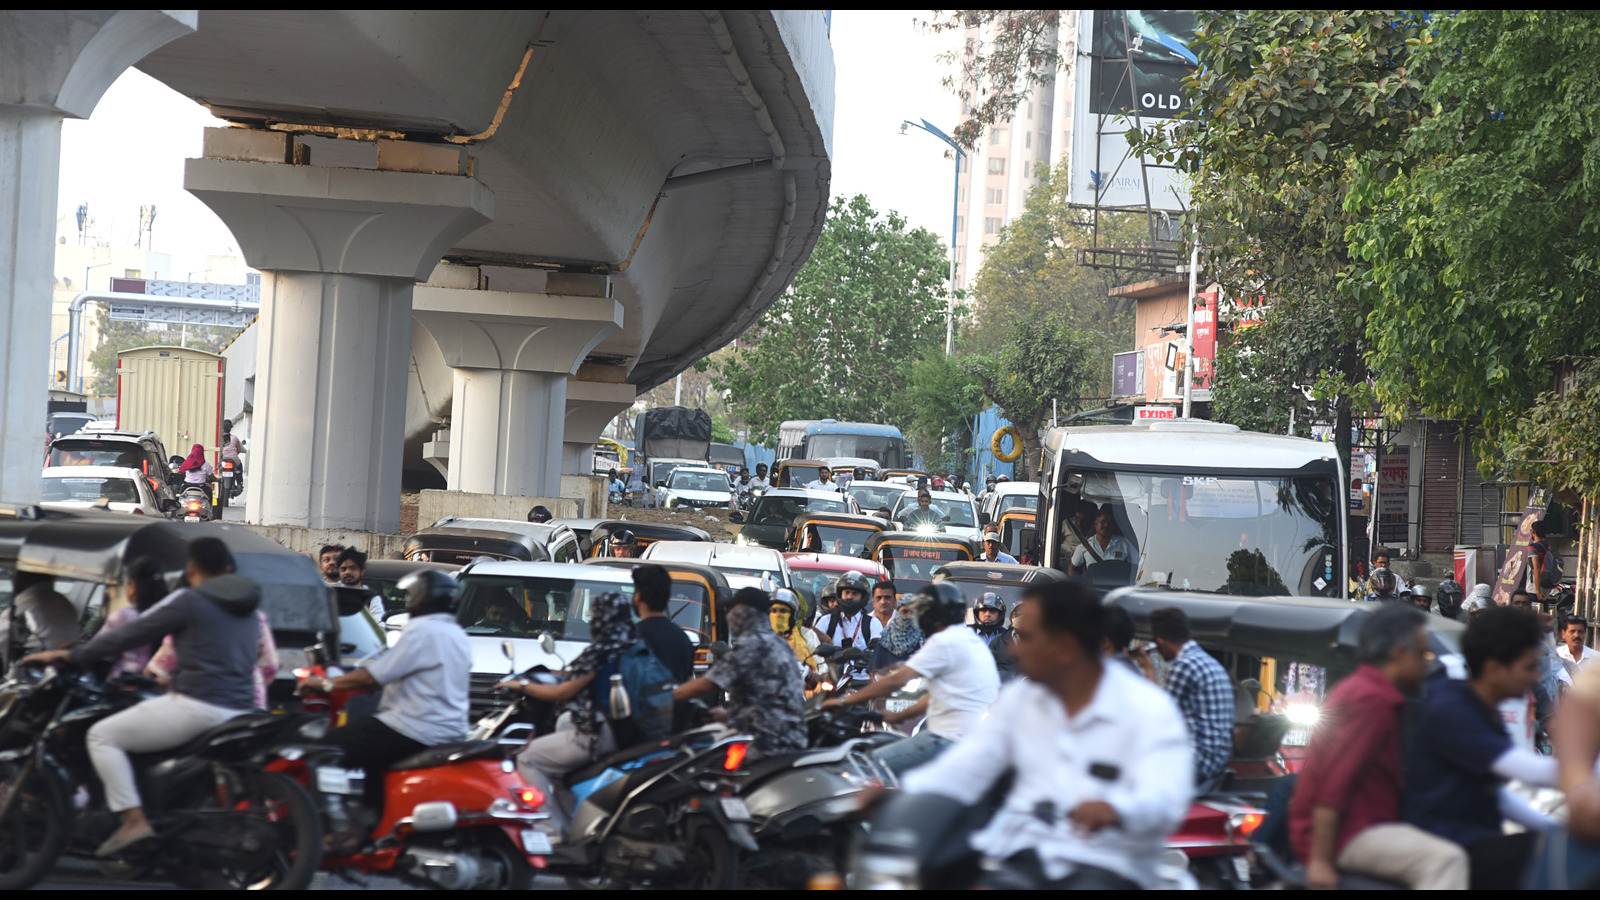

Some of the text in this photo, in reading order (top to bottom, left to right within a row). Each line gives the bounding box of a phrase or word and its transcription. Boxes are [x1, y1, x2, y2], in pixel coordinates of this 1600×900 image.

[1141, 92, 1181, 110] OLD
[1111, 177, 1140, 189] JAIRAJ
[1140, 410, 1174, 419] EXIDE
[1182, 477, 1217, 486] SKF
